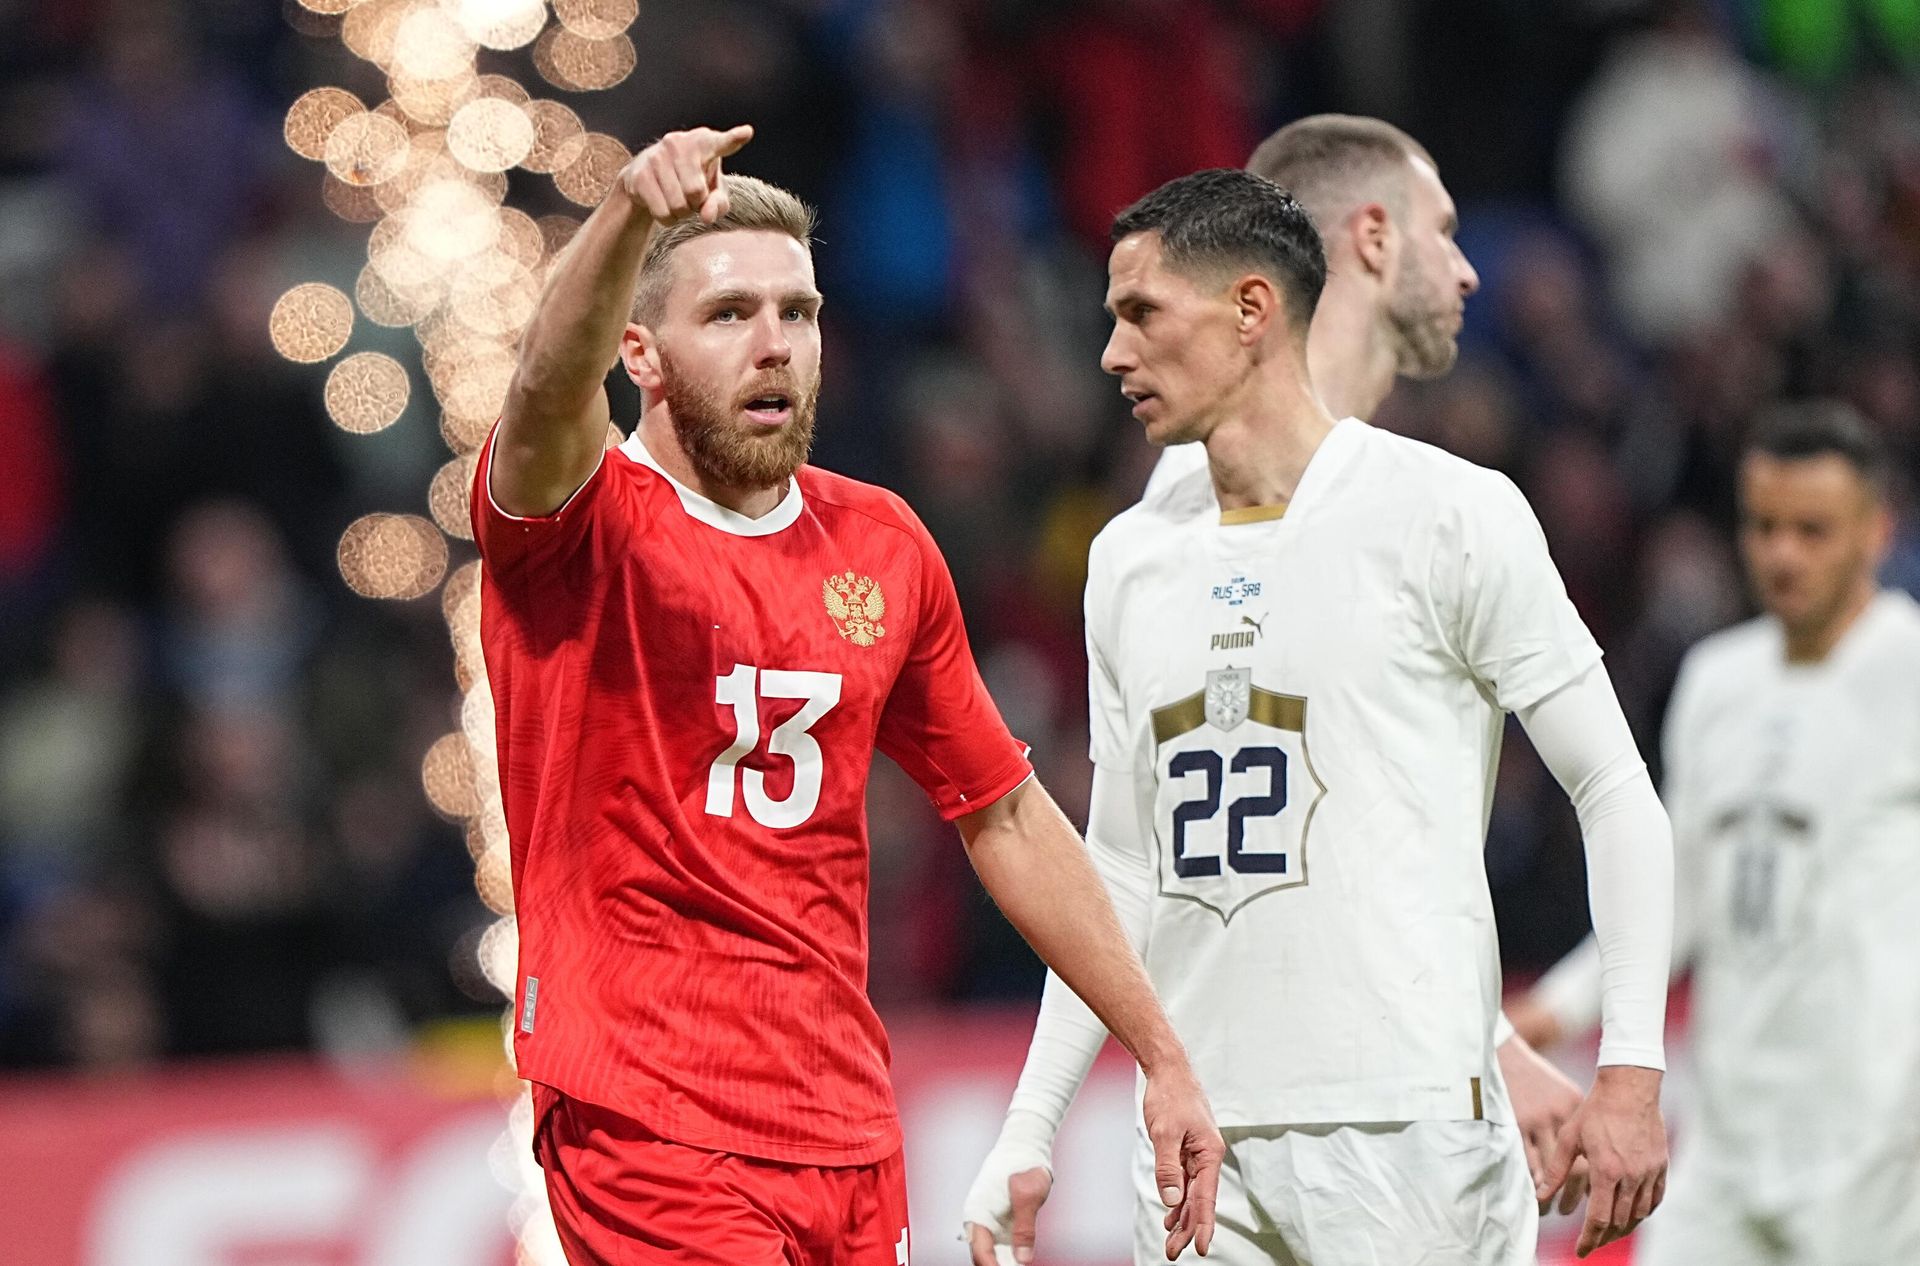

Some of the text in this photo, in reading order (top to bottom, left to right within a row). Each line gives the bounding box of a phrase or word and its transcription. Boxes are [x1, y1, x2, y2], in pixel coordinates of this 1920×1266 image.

[1211, 586, 1232, 599] RUS
[1241, 583, 1261, 597] SRB
[1210, 631, 1255, 650] PUMA
[704, 663, 843, 829] 13
[1168, 746, 1288, 879] 22
